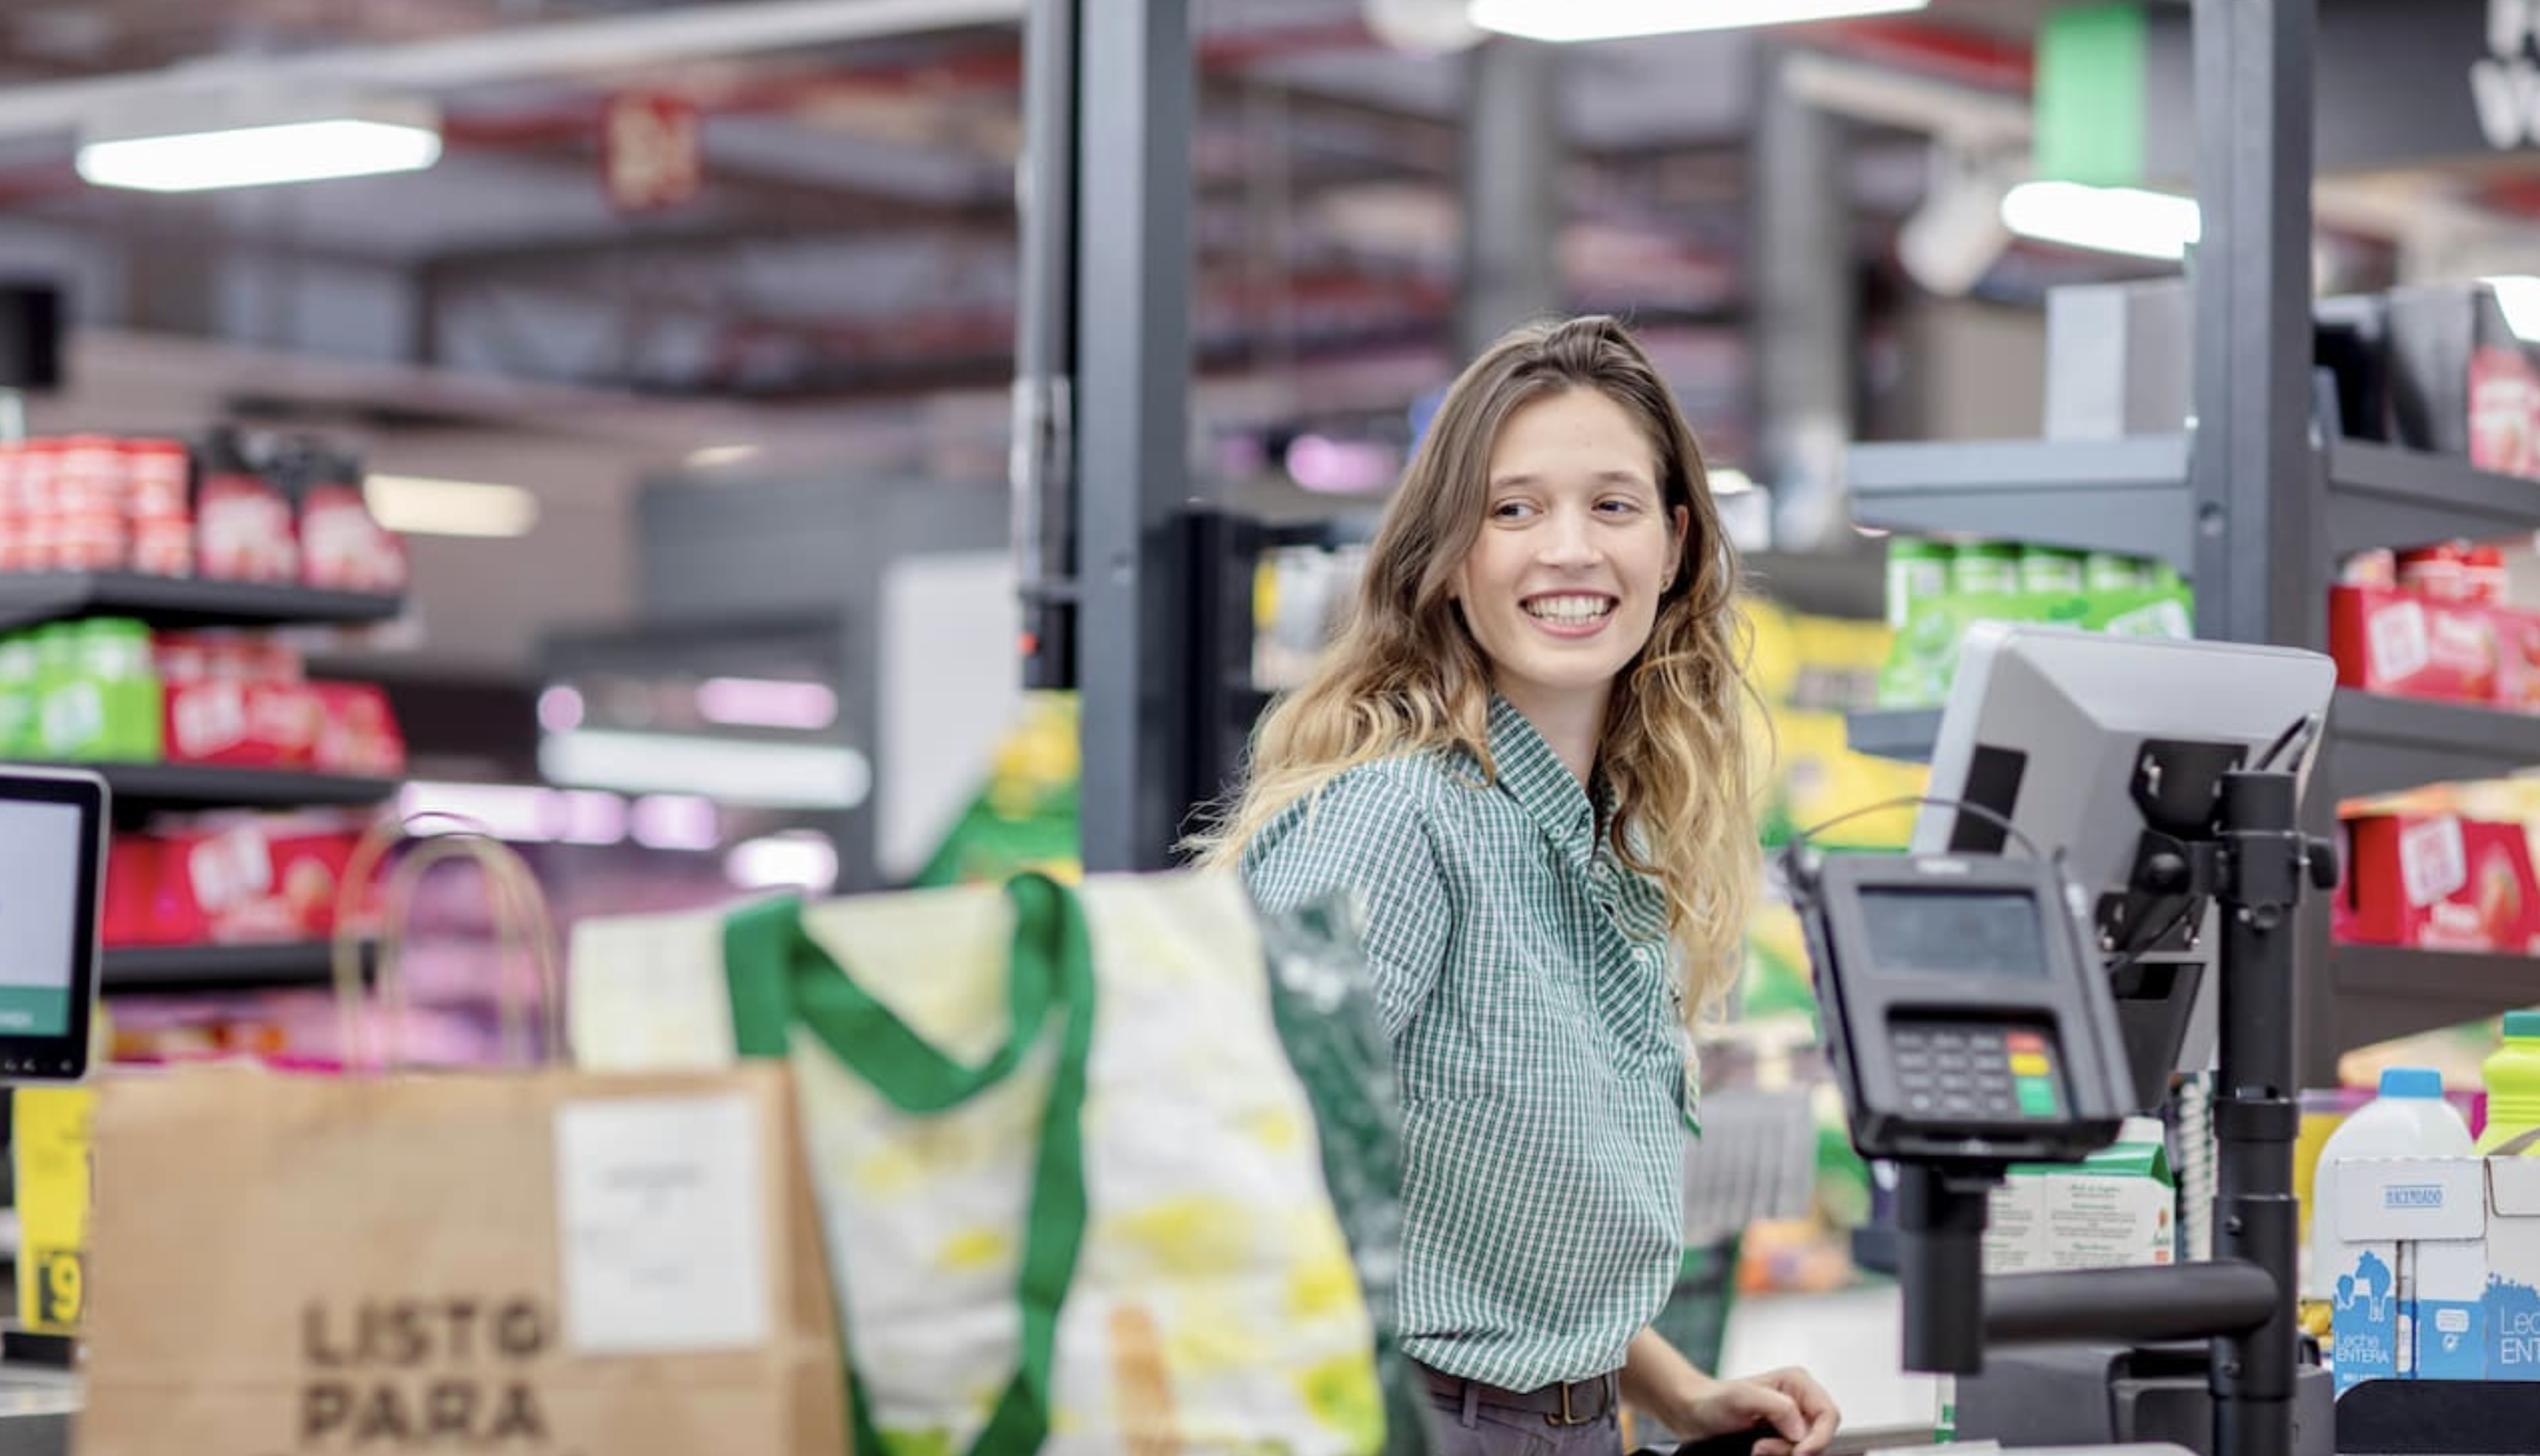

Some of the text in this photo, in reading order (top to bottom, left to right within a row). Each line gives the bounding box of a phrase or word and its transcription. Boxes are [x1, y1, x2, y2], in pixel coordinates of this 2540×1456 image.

[50, 1253, 81, 1320] 9
[301, 1297, 552, 1370] LISTO
[2335, 1331, 2380, 1349] Leche
[2335, 1349, 2390, 1364] ENTERA
[301, 1380, 555, 1443] PARA
